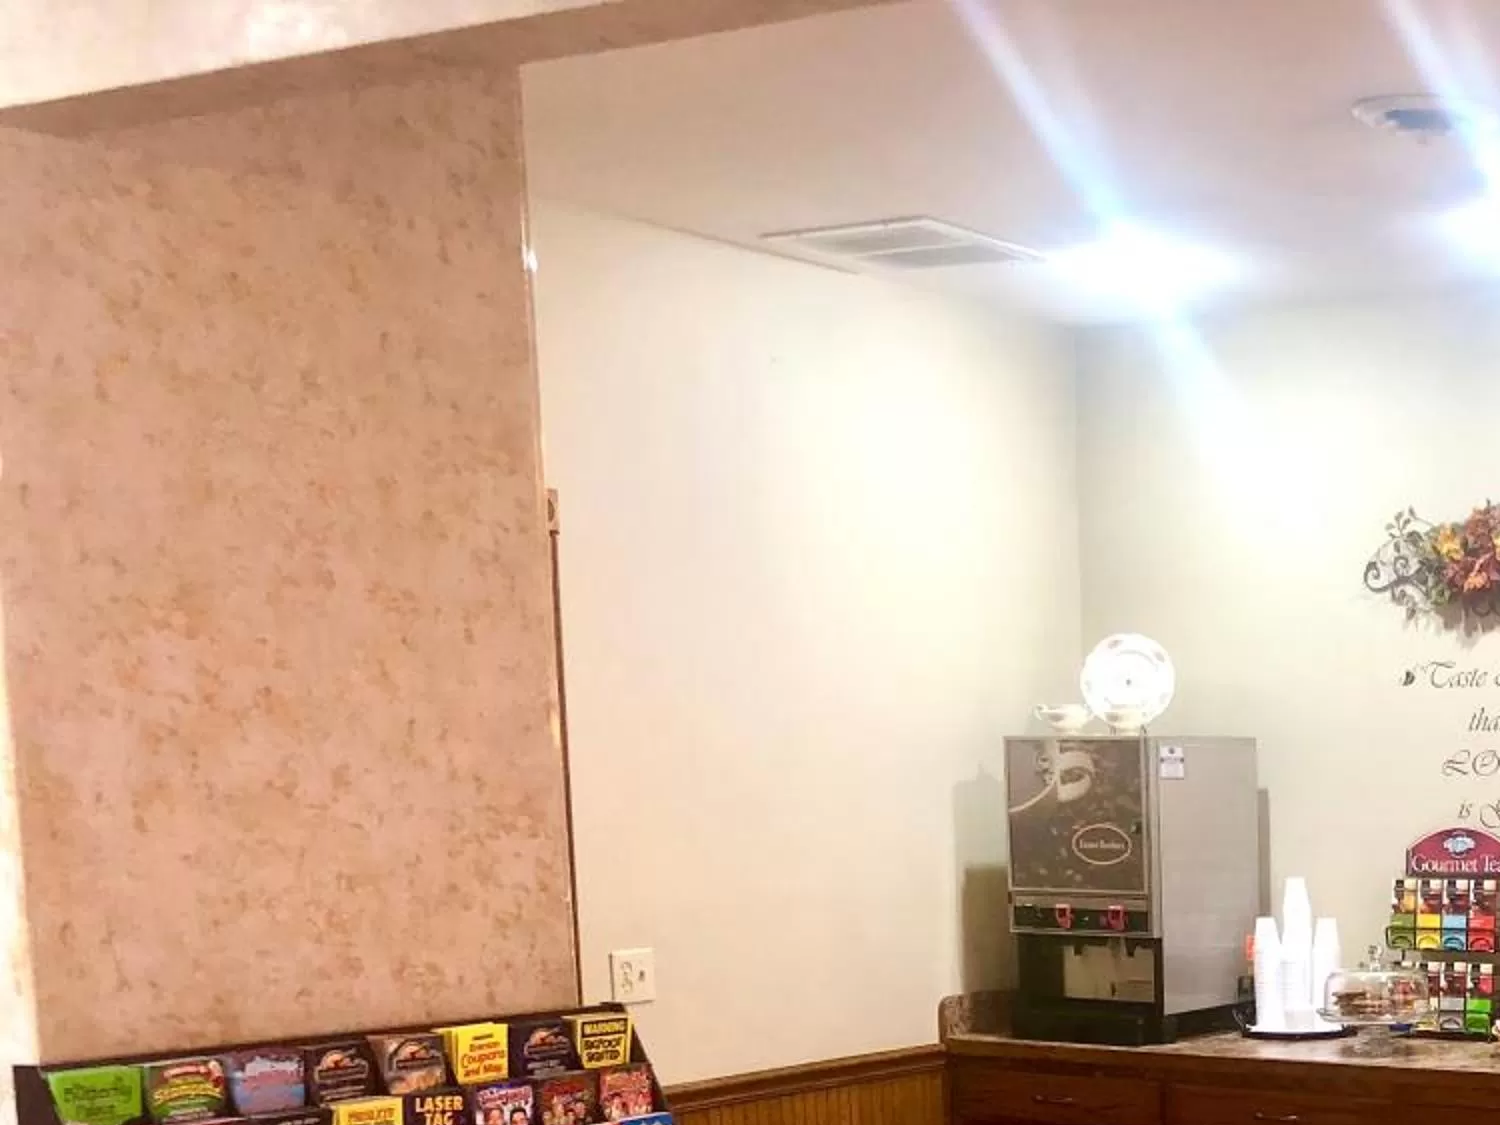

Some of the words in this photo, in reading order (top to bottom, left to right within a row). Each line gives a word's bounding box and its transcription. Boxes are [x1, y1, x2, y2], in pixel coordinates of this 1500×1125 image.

[1423, 660, 1488, 688] Taste
[1457, 800, 1472, 820] is
[1411, 854, 1478, 874] Gourmet
[461, 1050, 505, 1069] Coupons
[414, 1095, 464, 1114] LASER
